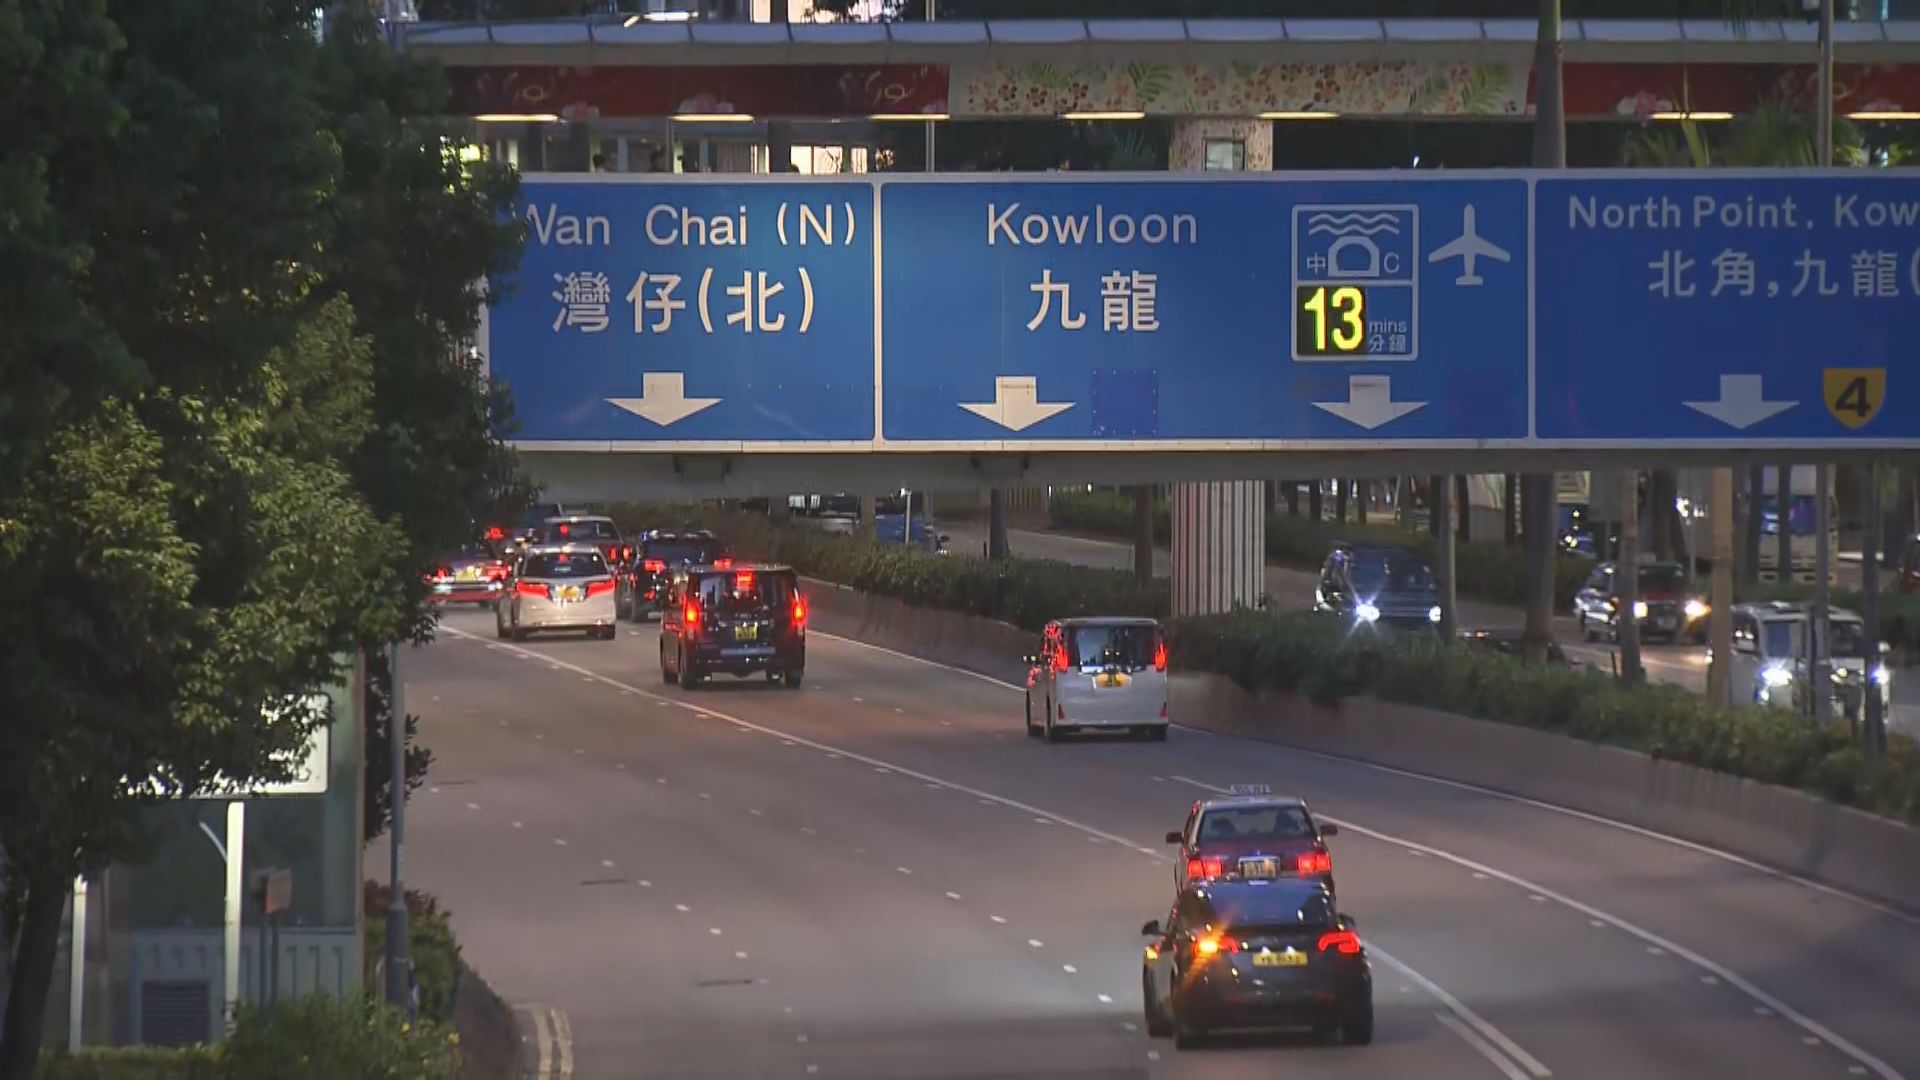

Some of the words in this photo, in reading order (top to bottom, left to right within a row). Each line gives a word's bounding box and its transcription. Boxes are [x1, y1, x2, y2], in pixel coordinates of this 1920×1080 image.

[645, 203, 747, 246] Chai
[776, 202, 855, 246] (N)
[987, 203, 1197, 246] Kowloon
[1568, 195, 1681, 229] North
[1834, 194, 1920, 227] Kow
[1306, 252, 1326, 275] 中
[1383, 252, 1400, 274] C
[552, 266, 814, 334] 灣仔(北)
[1027, 270, 1160, 332] 九龍
[1304, 285, 1365, 351] 13
[1368, 317, 1407, 334] mins
[1835, 376, 1871, 417] 4
